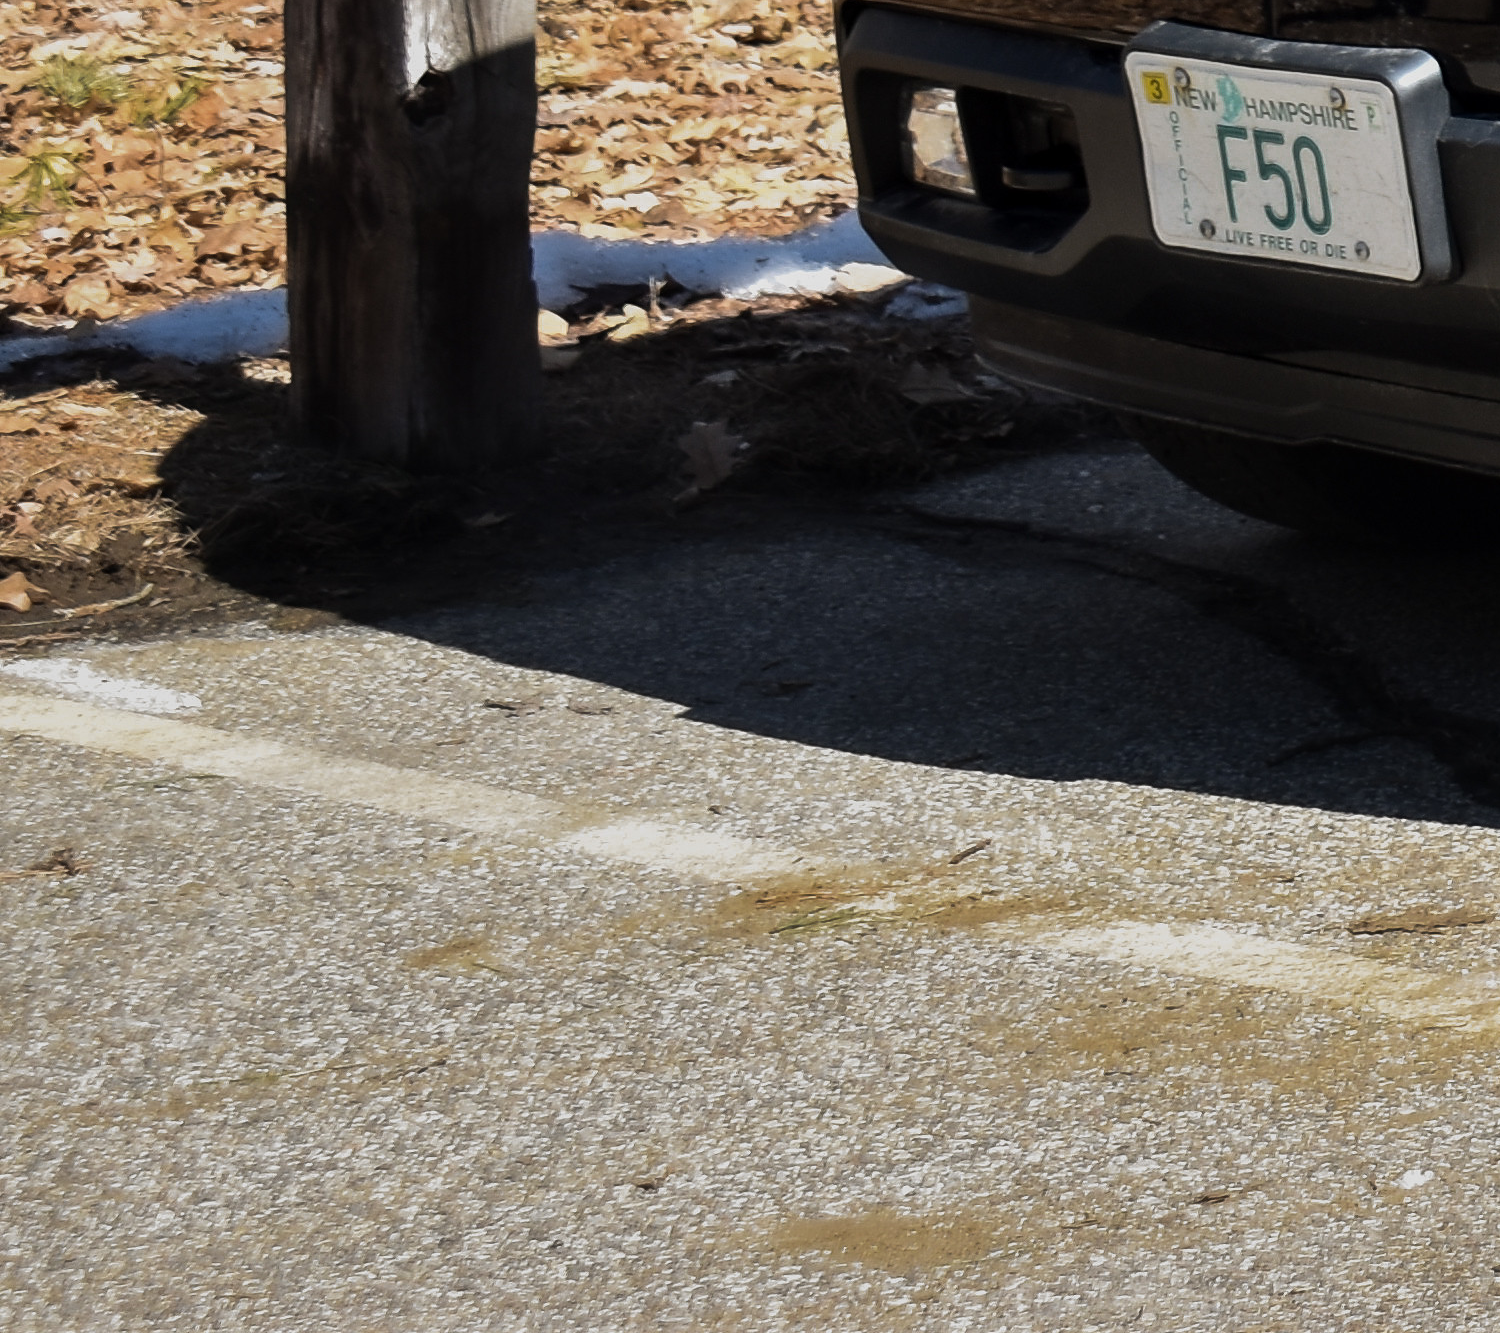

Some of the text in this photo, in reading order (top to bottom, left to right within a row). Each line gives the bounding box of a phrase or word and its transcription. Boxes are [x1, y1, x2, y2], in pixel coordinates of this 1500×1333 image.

[1150, 80, 1163, 100] 3
[1173, 86, 1359, 131] NEW HAMPSHIRE
[1168, 110, 1193, 225] OFFICIAL
[1216, 123, 1333, 235] F50
[1225, 229, 1348, 260] LIVE FREE OR DIE
